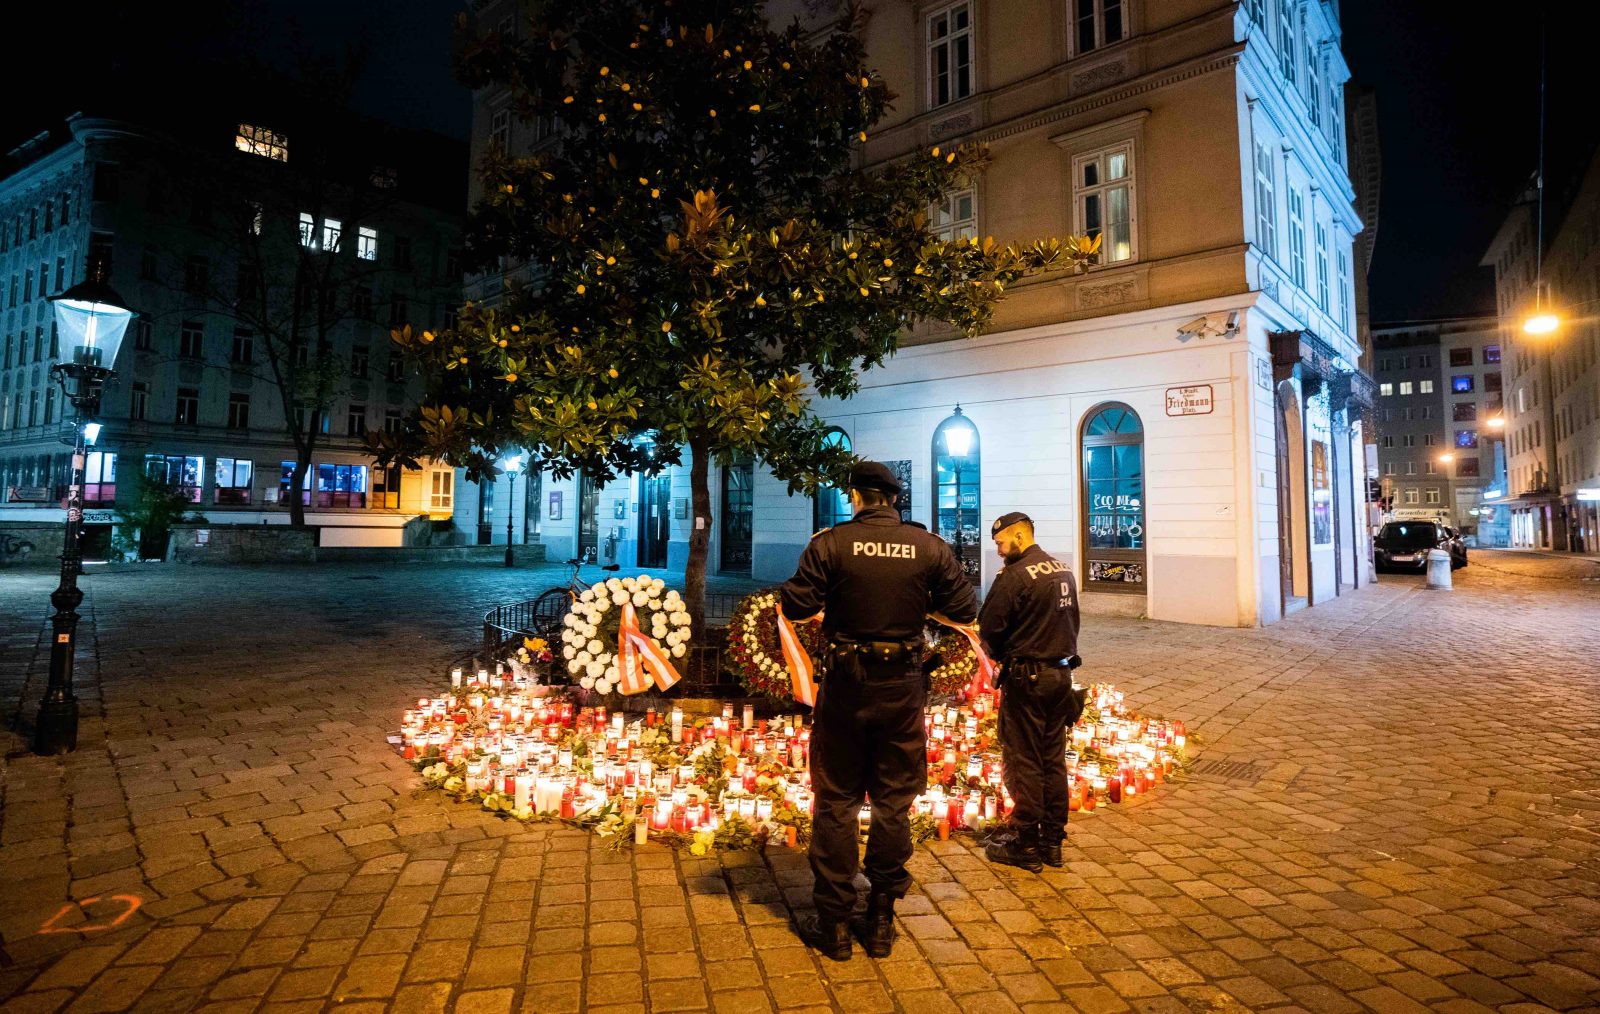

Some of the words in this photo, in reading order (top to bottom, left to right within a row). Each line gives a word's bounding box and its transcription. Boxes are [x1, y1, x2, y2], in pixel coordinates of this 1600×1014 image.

[853, 541, 916, 559] POLIZEI
[1060, 582, 1069, 596] D
[1059, 597, 1072, 608] 214
